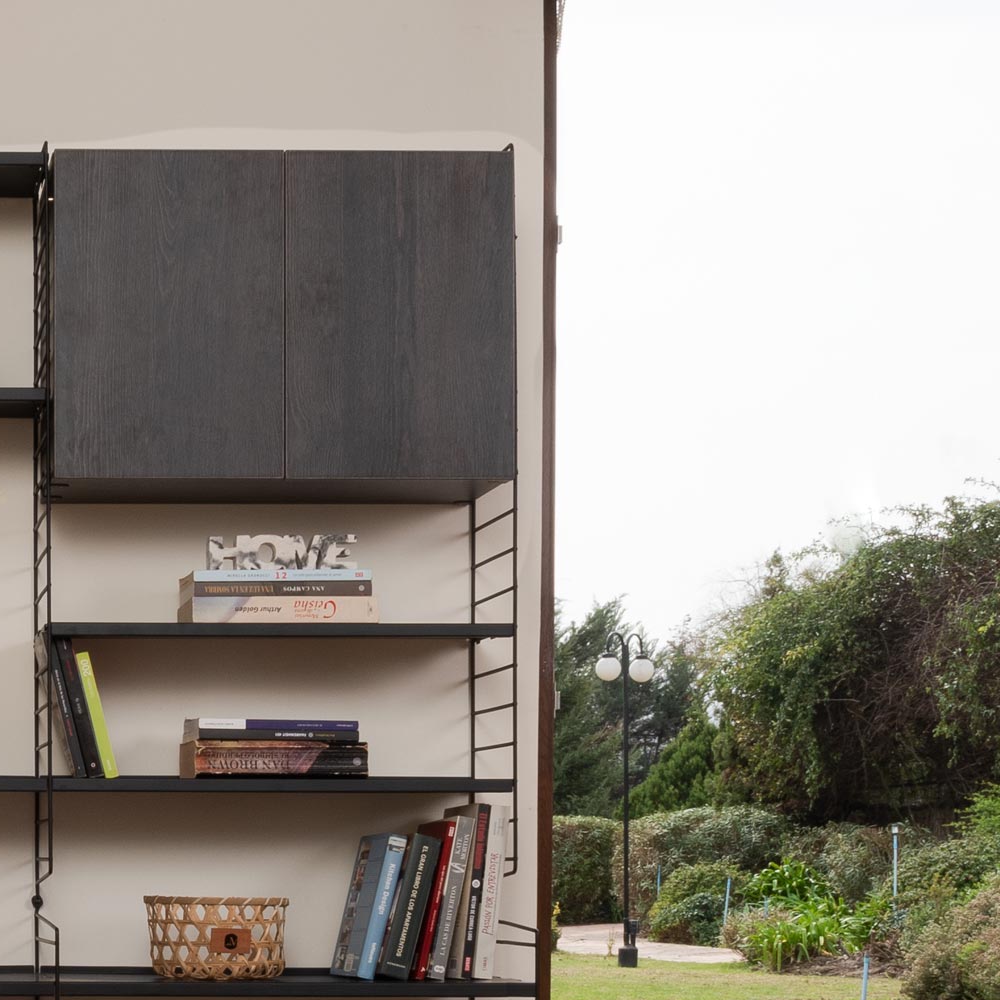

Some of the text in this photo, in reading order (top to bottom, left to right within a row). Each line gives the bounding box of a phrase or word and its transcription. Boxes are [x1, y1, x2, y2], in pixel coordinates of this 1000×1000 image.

[206, 534, 358, 570] HOME
[293, 600, 337, 620] Geisha
[207, 760, 289, 770] DAN BROWN
[461, 834, 470, 860] MORTON
[418, 854, 427, 871] GRAN
[378, 863, 396, 915] Kitchen Design
[413, 872, 422, 889] LIBRO
[408, 899, 416, 911] LOS
[447, 885, 457, 920] RIVERTON
[396, 912, 413, 957] APARTAMENTOS
[444, 922, 451, 931] DE
[440, 947, 446, 956] LA
